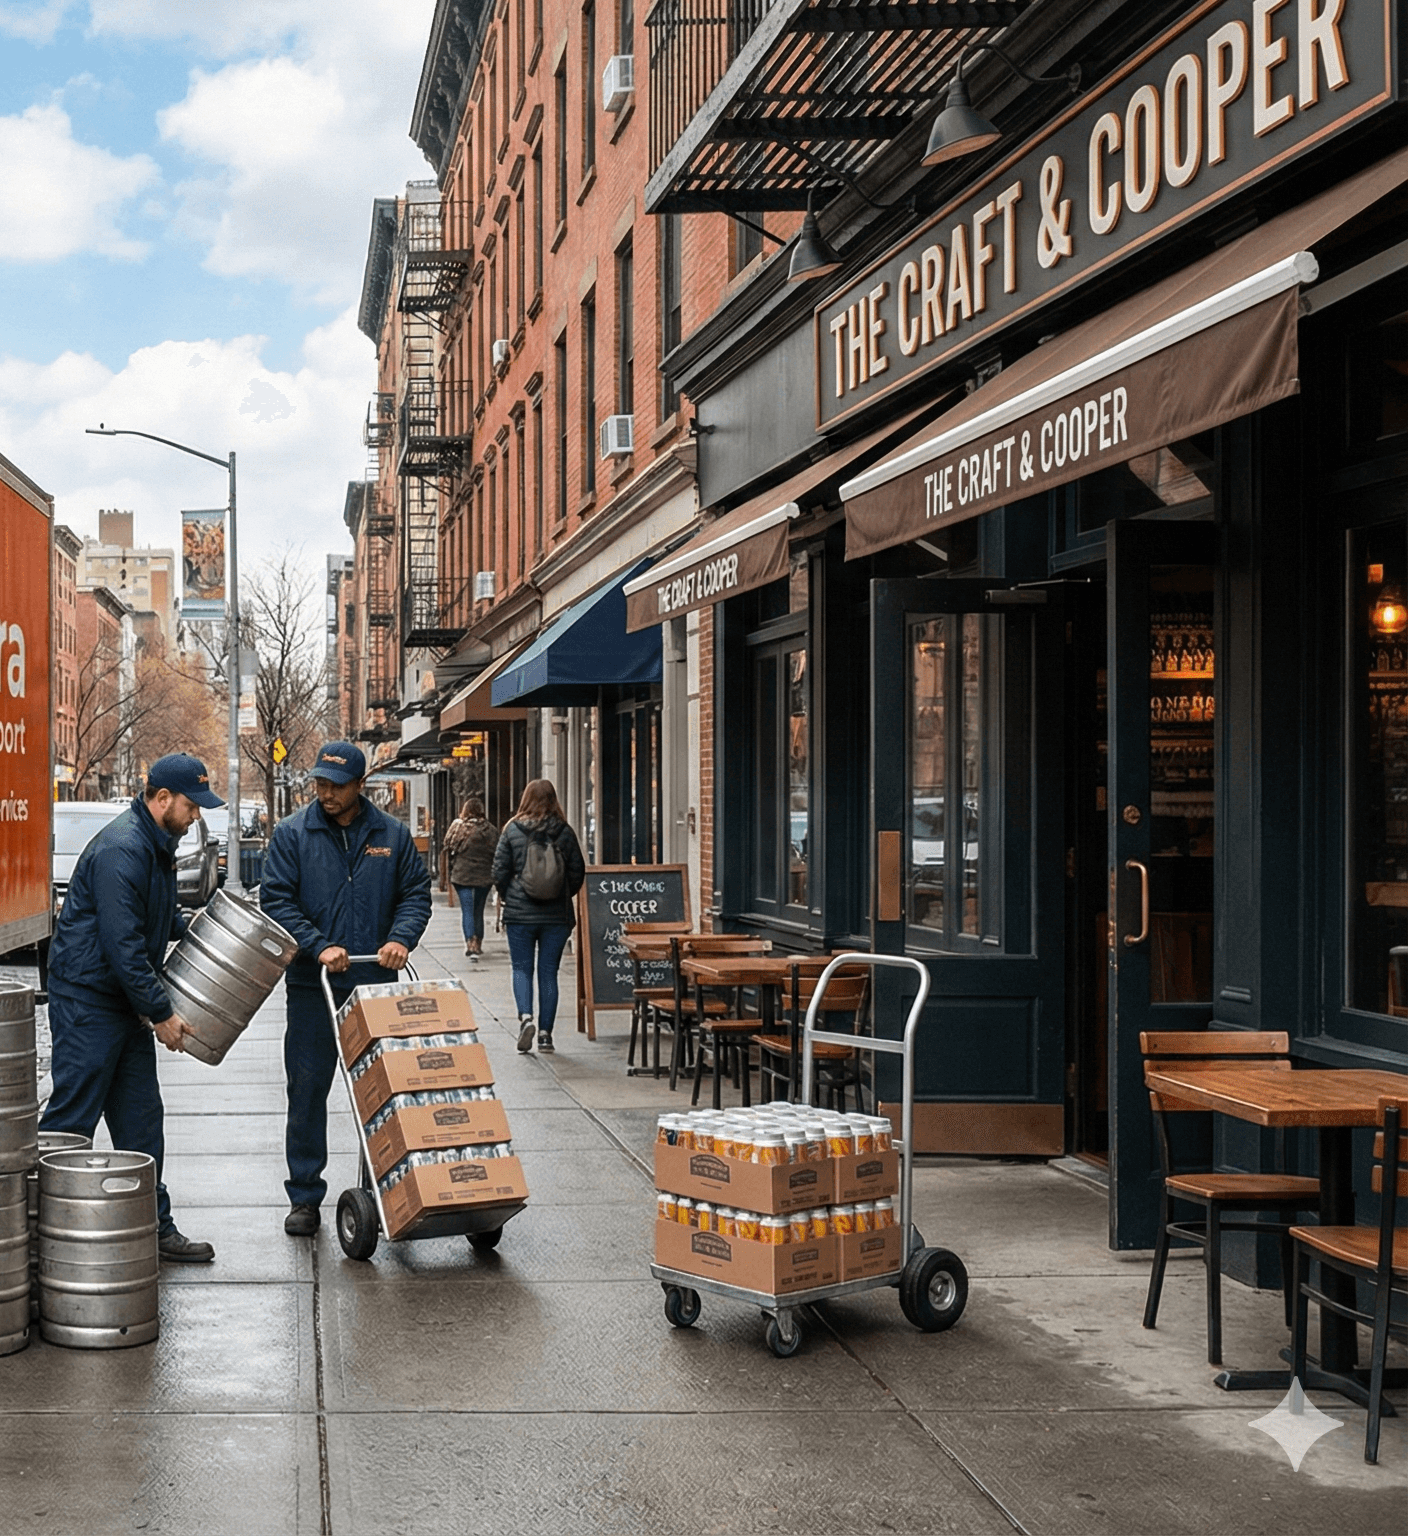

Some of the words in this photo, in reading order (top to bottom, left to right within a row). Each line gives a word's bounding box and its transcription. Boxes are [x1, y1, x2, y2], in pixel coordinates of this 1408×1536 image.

[829, 281, 890, 398] THE
[897, 178, 1022, 356] CRAFT
[1037, 155, 1072, 269] &
[1088, 0, 1350, 235] COOPER
[924, 464, 953, 519] THE
[958, 435, 1016, 506] CRAFT
[1019, 430, 1034, 481] &
[1040, 386, 1128, 473] COOPER
